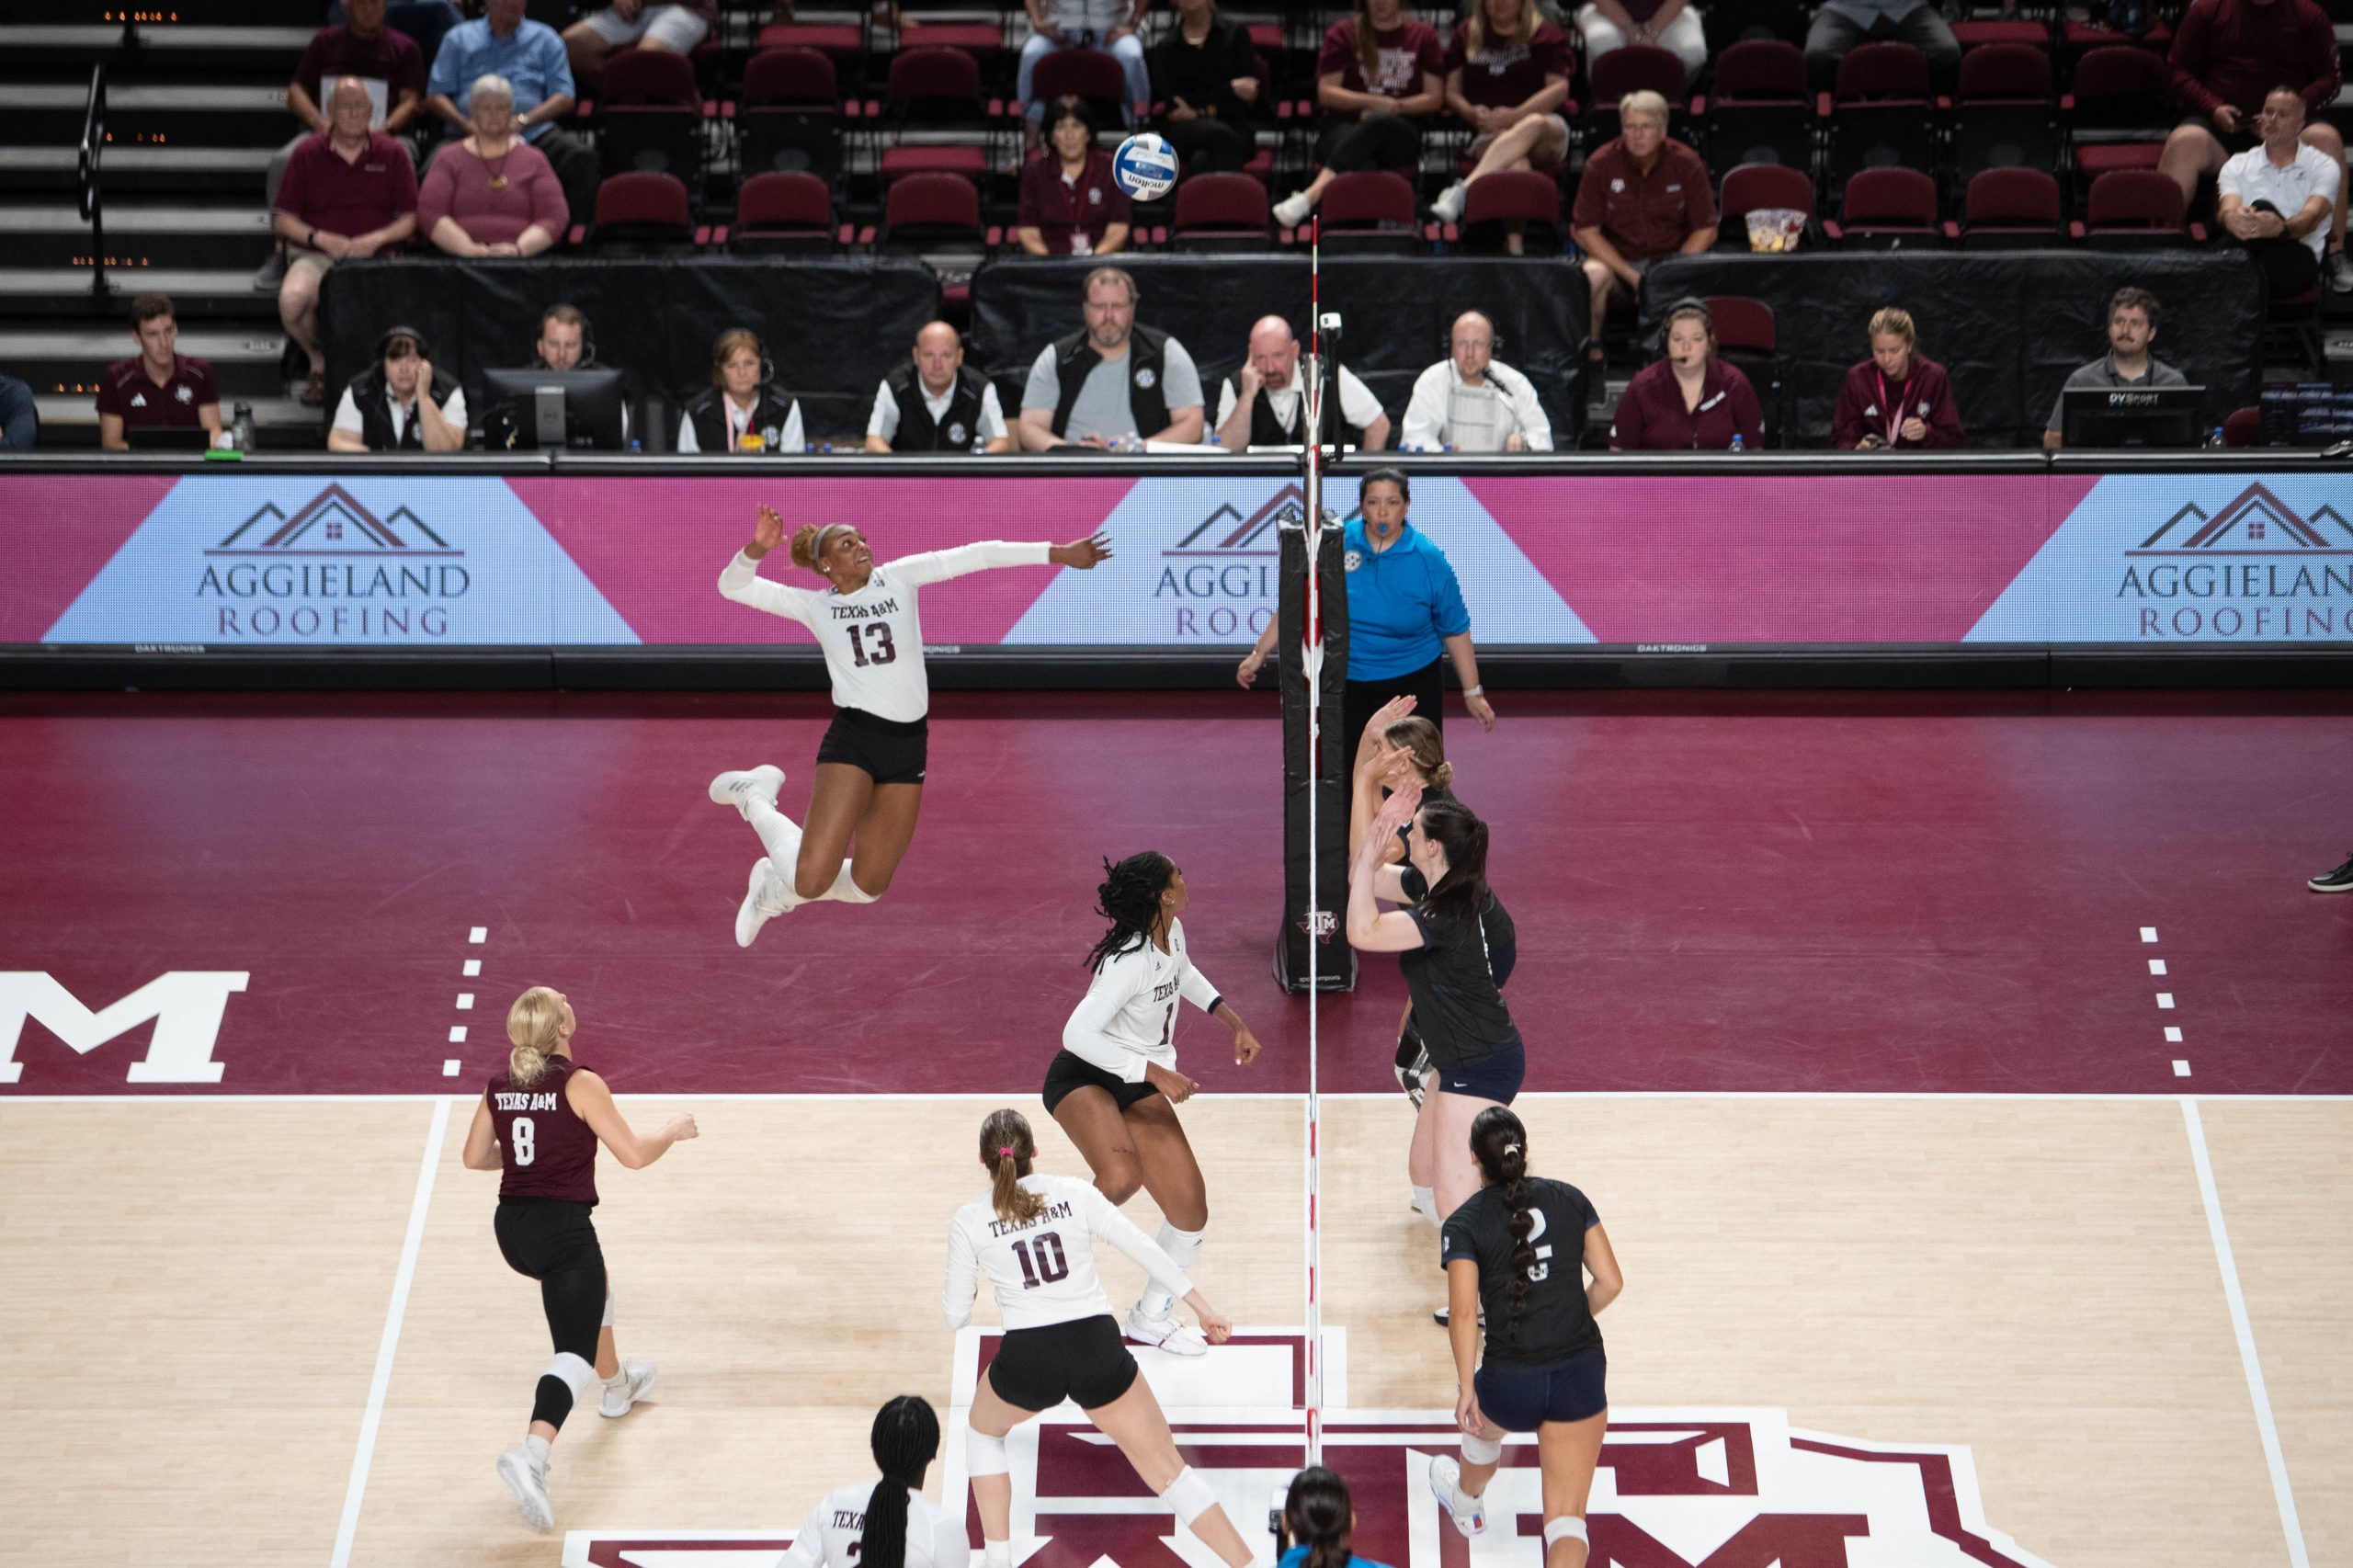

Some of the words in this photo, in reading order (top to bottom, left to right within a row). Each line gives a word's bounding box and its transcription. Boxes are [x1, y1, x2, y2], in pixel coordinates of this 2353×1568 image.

[1129, 175, 1165, 188] molten
[197, 563, 470, 597] AGGIELAND
[2118, 563, 2353, 597] AGGIELAN
[220, 606, 448, 636] ROOFING
[846, 621, 896, 668] 13
[1637, 644, 1707, 653] DAKTRONICS
[1153, 981, 1174, 1003] TEXAS
[1158, 1002, 1174, 1046] 1
[494, 1092, 530, 1110] TEXAS
[529, 1092, 557, 1111] A&M
[512, 1117, 535, 1165] 8
[1042, 1200, 1073, 1224] A&M
[1011, 1232, 1069, 1290] 10
[832, 1510, 866, 1532] TEXA
